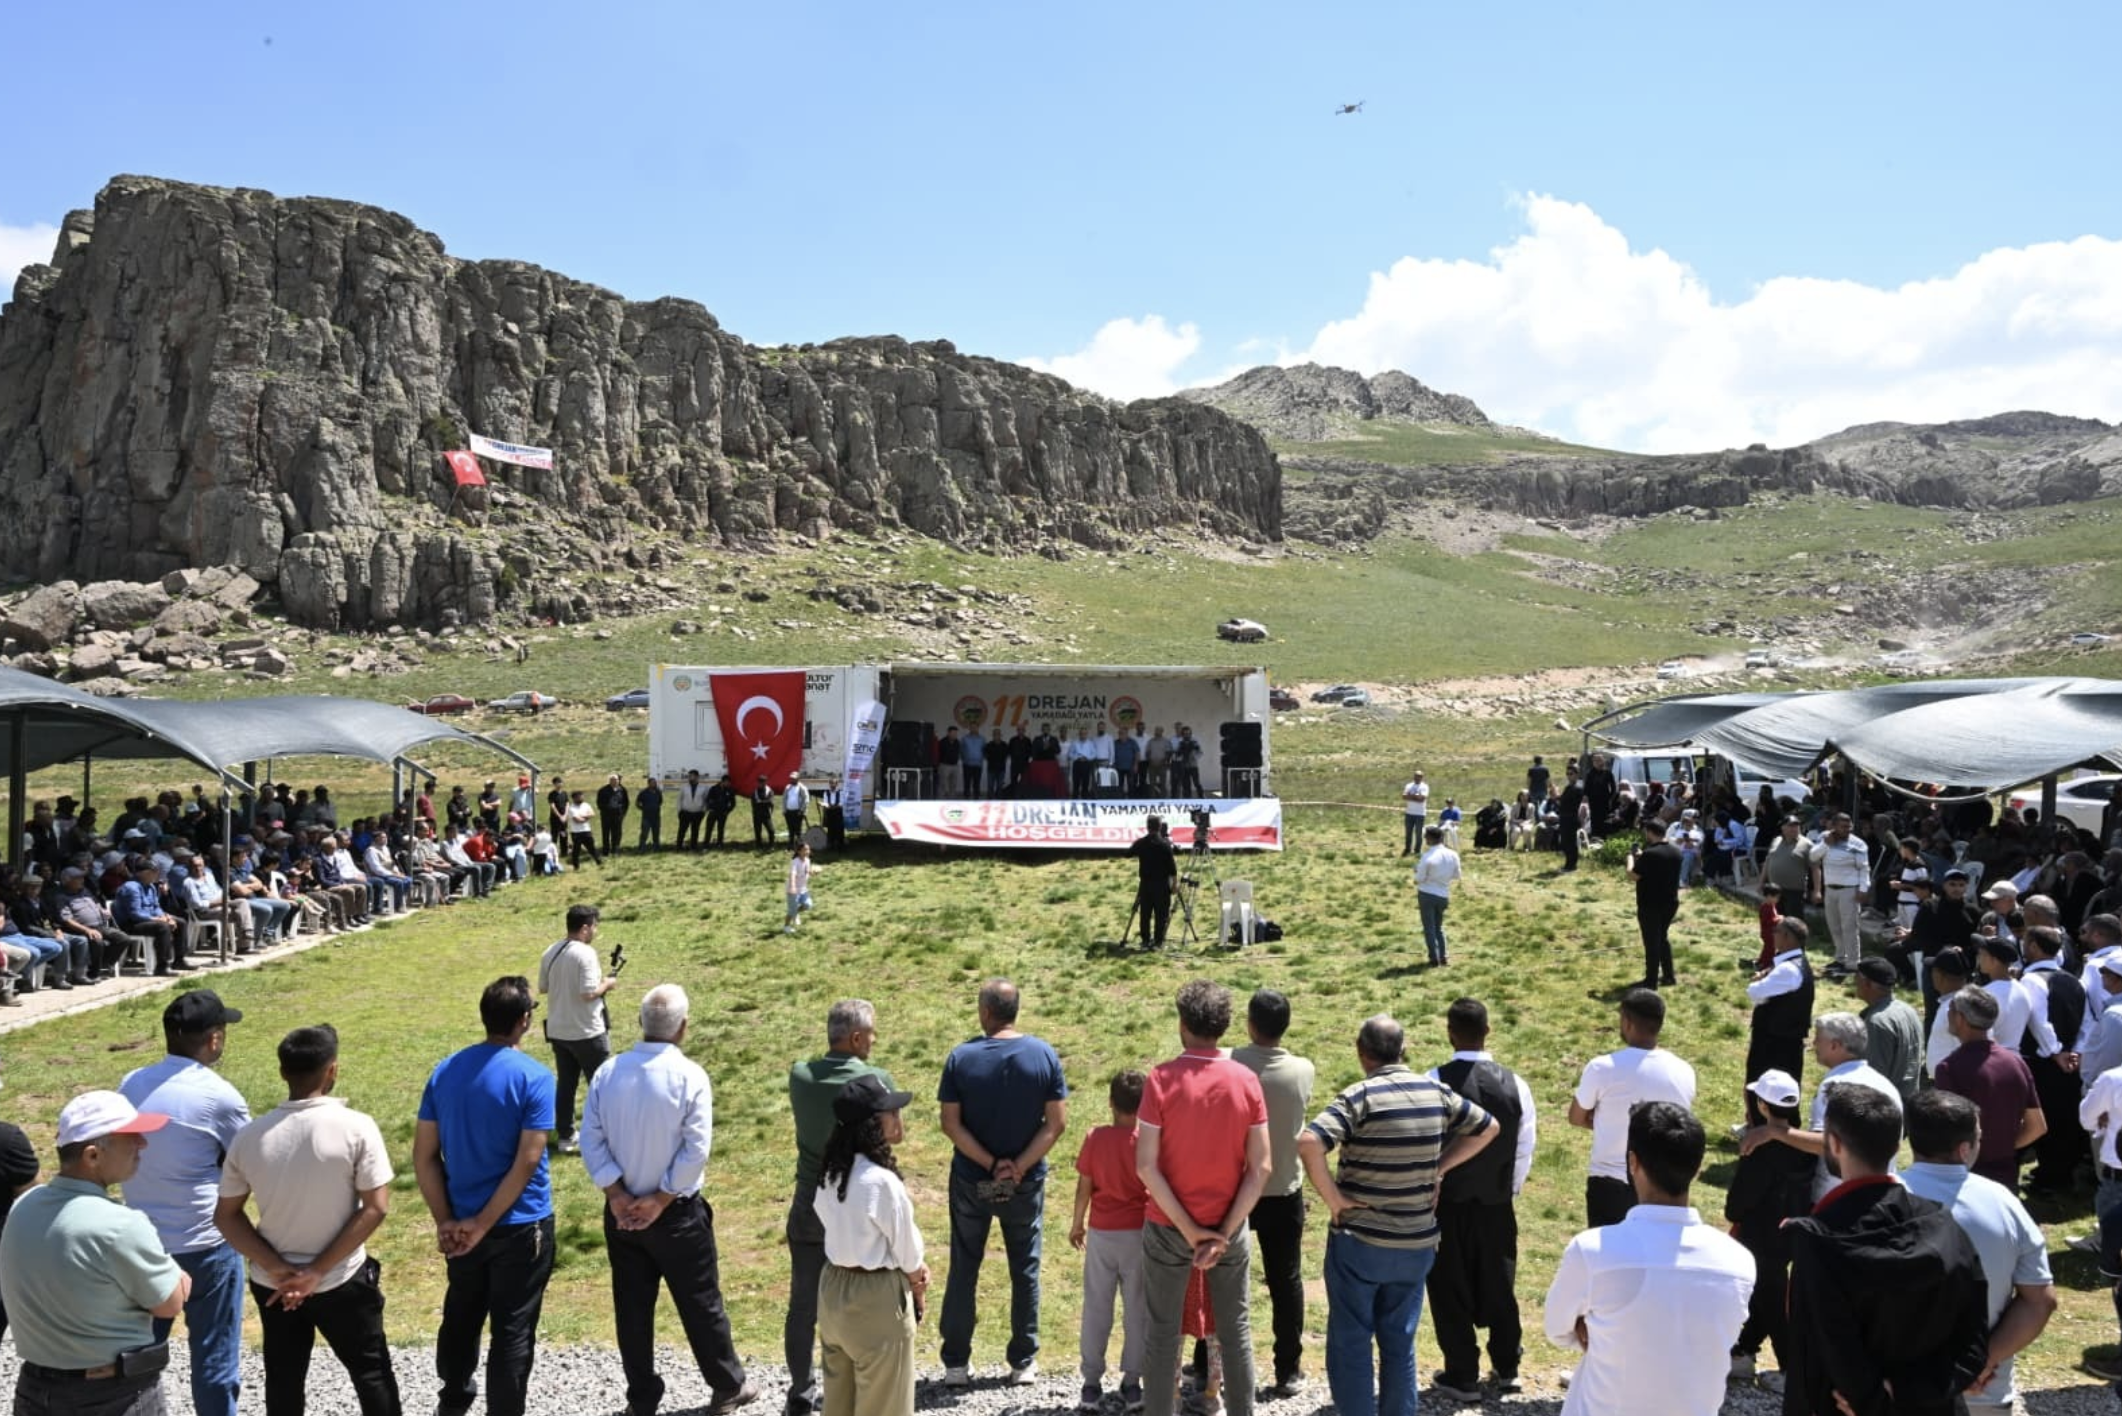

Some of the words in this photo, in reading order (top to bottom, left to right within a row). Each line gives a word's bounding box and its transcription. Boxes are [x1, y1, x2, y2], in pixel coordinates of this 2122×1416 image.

[1028, 695, 1106, 709] DREJAN
[1077, 711, 1105, 719] YAYLA
[1013, 802, 1097, 826] DREJAN
[1100, 802, 1171, 815] YAMADAĞI
